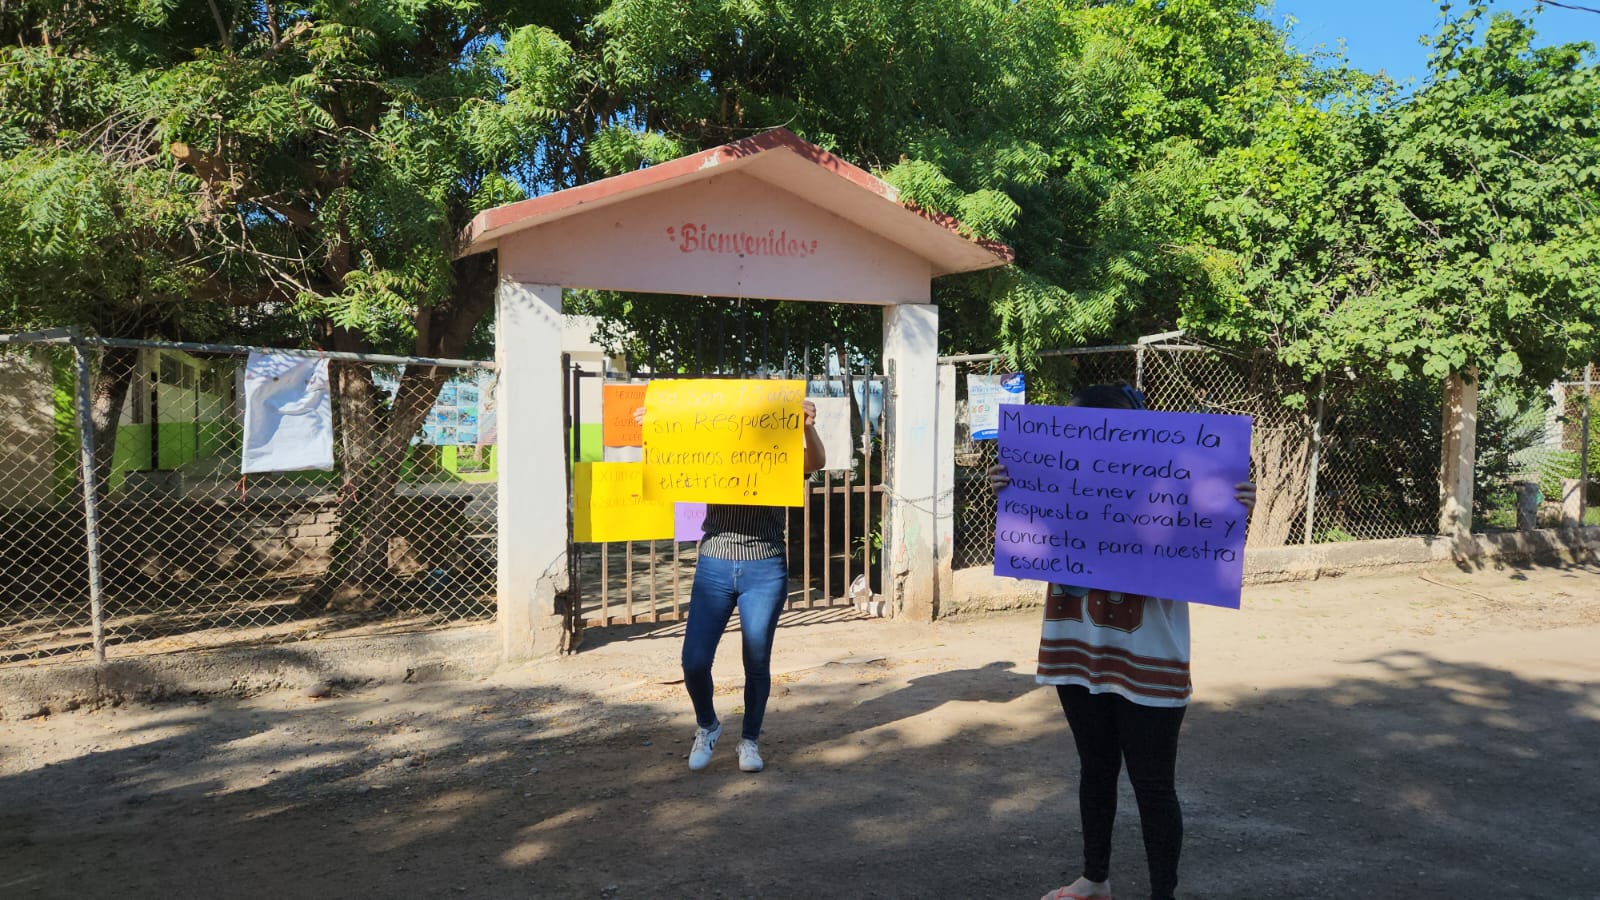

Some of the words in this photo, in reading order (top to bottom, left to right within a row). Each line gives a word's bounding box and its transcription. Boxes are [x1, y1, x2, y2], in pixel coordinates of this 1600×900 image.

[679, 222, 808, 257] Bienvenidos
[694, 408, 800, 440] Respuesta
[1002, 411, 1186, 445] Mantendremos
[1195, 423, 1221, 448] la
[1000, 446, 1080, 471] escuela
[1092, 459, 1191, 480] cerrada
[1072, 477, 1137, 500] tener
[1148, 490, 1189, 506] una
[1004, 499, 1089, 524] respuesta
[1100, 503, 1213, 529] favorable
[1224, 518, 1237, 539] y
[1000, 527, 1087, 551] concreta
[1098, 539, 1144, 556] para
[1153, 540, 1236, 563] nuestra
[1009, 553, 1093, 575] escuela.
